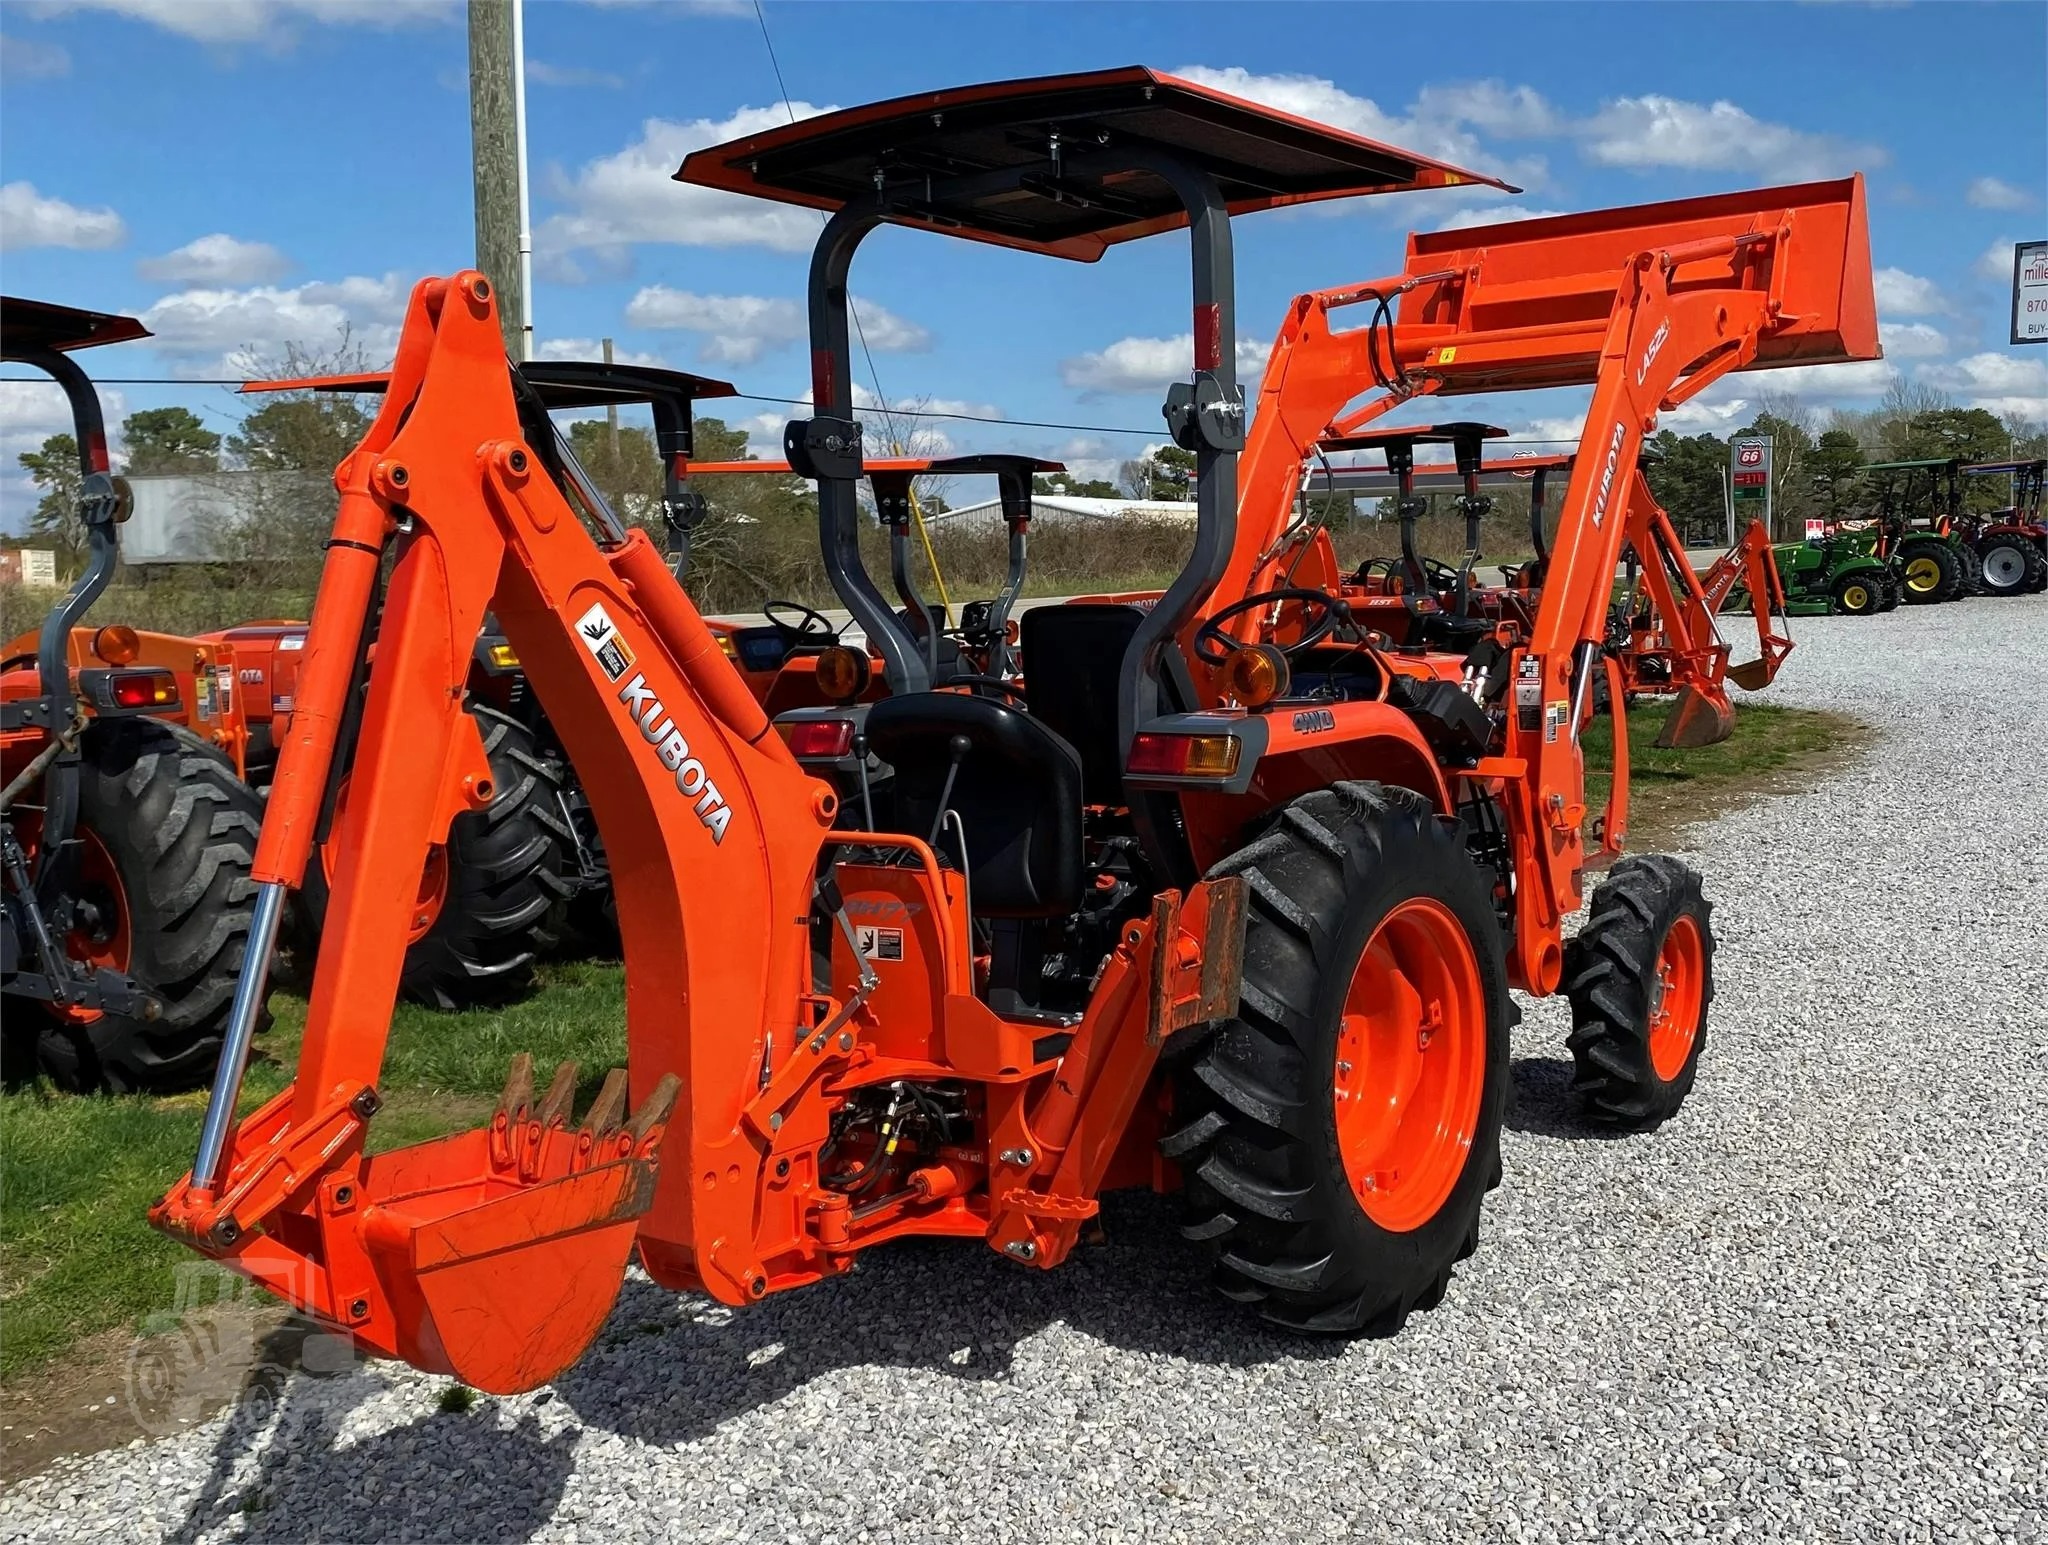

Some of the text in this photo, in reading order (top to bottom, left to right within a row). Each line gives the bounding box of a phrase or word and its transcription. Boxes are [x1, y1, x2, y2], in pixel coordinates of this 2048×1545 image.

[1593, 421, 1626, 531] KUBOTA
[1741, 451, 1759, 462] 66
[1292, 709, 1336, 735] 4WD
[618, 671, 733, 847] KUBOTA
